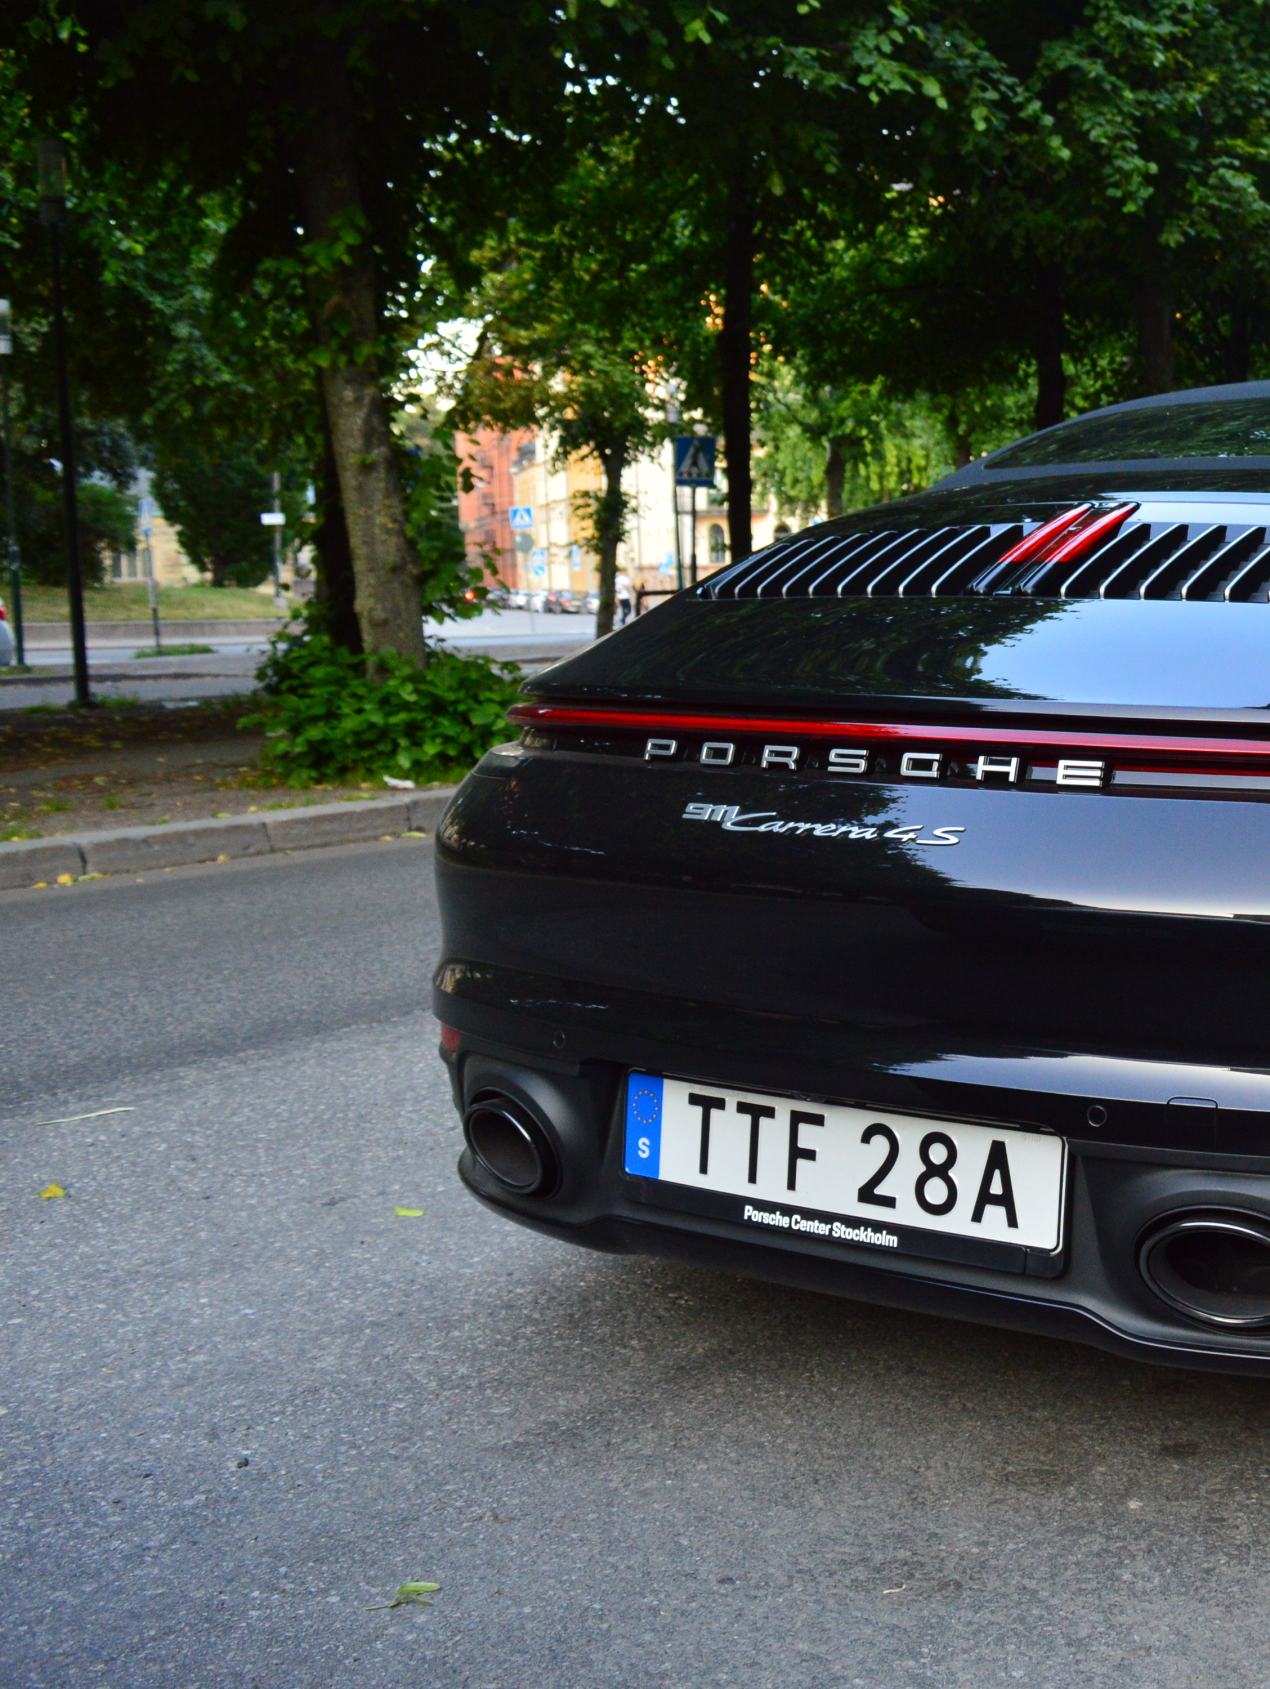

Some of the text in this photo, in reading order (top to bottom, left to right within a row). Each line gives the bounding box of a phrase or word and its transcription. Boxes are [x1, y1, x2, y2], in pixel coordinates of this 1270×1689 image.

[644, 738, 1106, 787] PORSCHE
[682, 802, 740, 822] 911
[721, 812, 879, 840] Carrera
[637, 1137, 650, 1159] S
[688, 1092, 1019, 1229] TTF 28A
[744, 1205, 898, 1248] Porsche Center Stockholm
